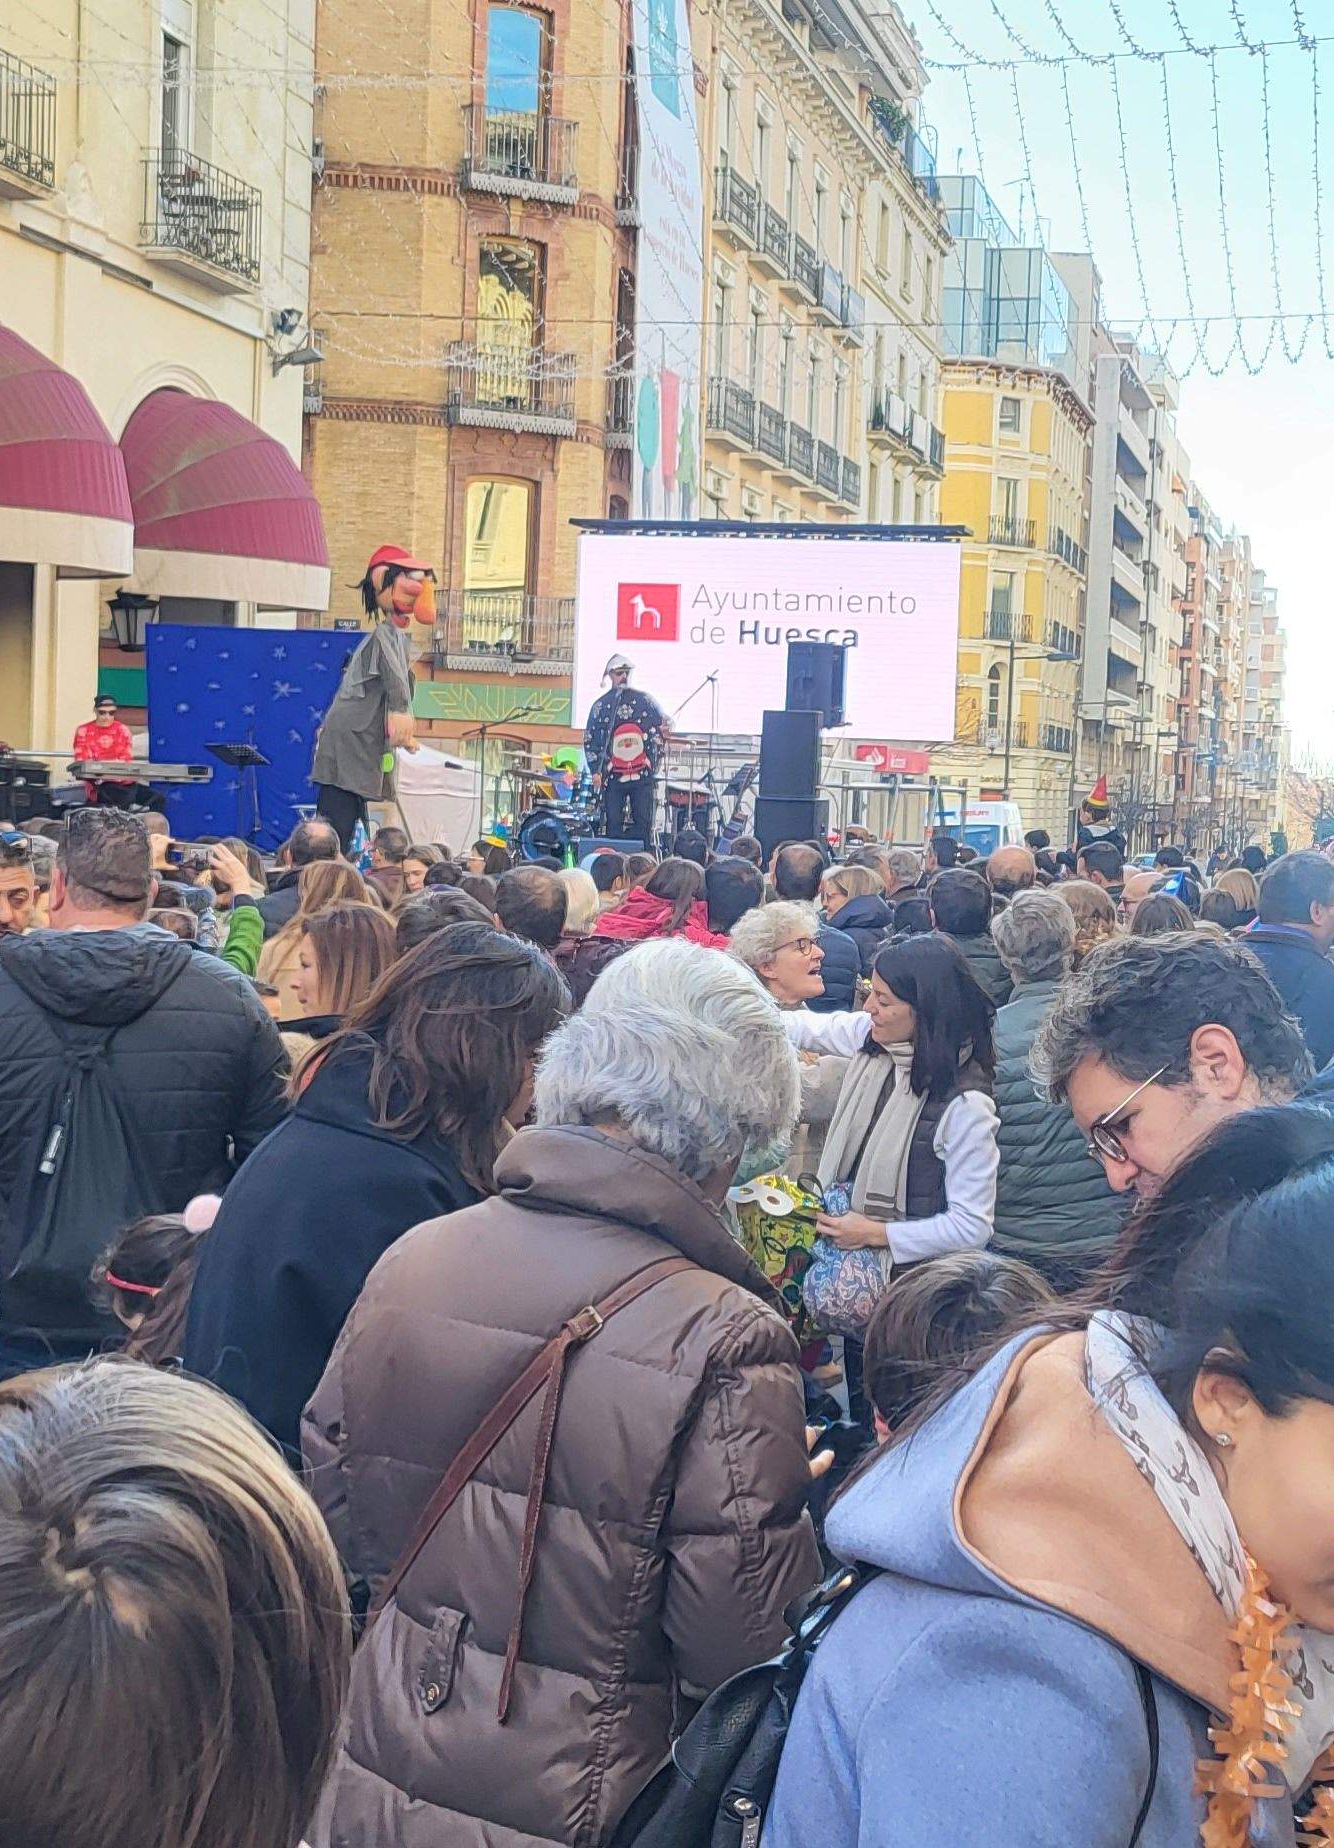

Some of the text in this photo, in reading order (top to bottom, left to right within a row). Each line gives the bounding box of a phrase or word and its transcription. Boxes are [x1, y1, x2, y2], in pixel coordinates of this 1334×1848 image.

[691, 584, 916, 616] Ayuntamiento
[690, 621, 859, 647] de Huesca
